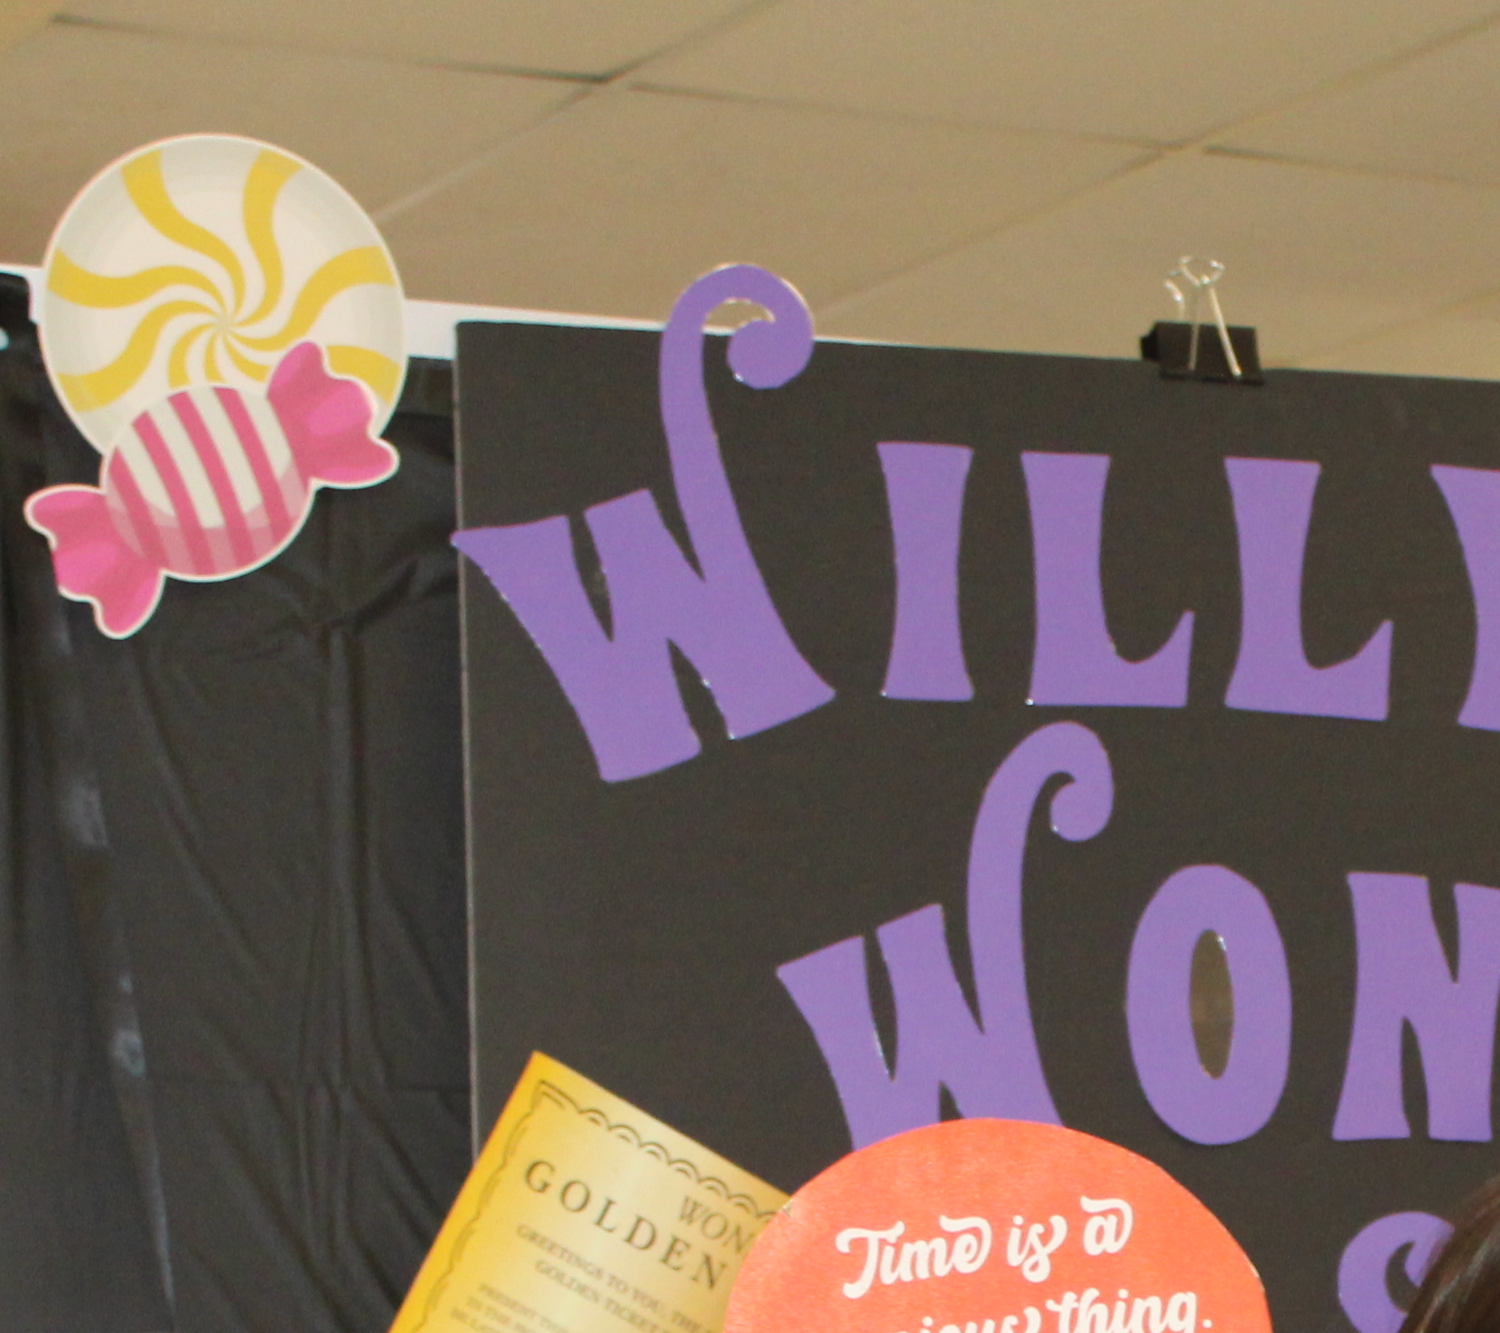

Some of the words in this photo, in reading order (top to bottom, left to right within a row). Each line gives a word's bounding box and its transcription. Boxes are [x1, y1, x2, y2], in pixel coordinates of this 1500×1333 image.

[523, 1159, 729, 1291] GOLDEN
[836, 1213, 992, 1299] Time
[1006, 1215, 1068, 1283] is
[1080, 1196, 1134, 1257] a
